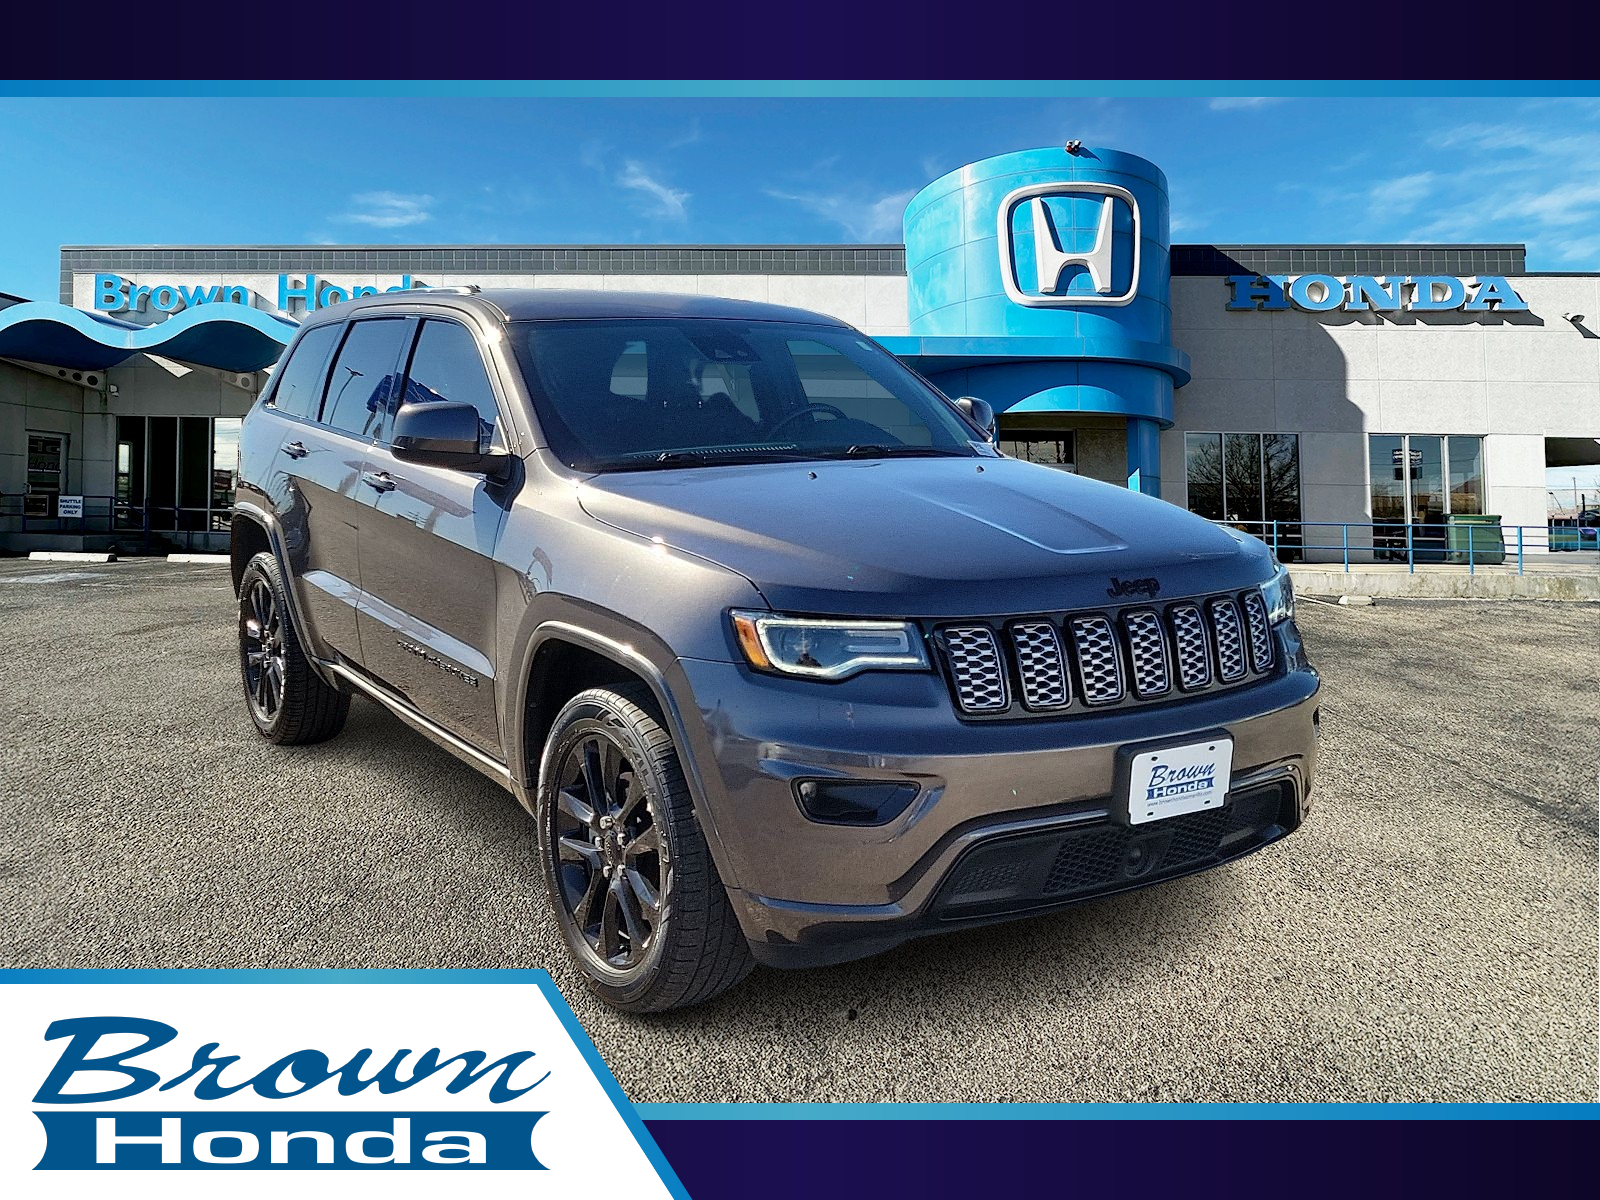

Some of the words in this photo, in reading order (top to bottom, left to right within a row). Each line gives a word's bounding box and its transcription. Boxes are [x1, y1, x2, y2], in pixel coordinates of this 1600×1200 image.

[94, 273, 249, 311] Brown
[278, 273, 412, 311] Hond
[1225, 273, 1529, 311] HONDA
[1106, 576, 1160, 598] Jeep
[1148, 762, 1216, 788] Brown
[1153, 780, 1208, 798] Honda
